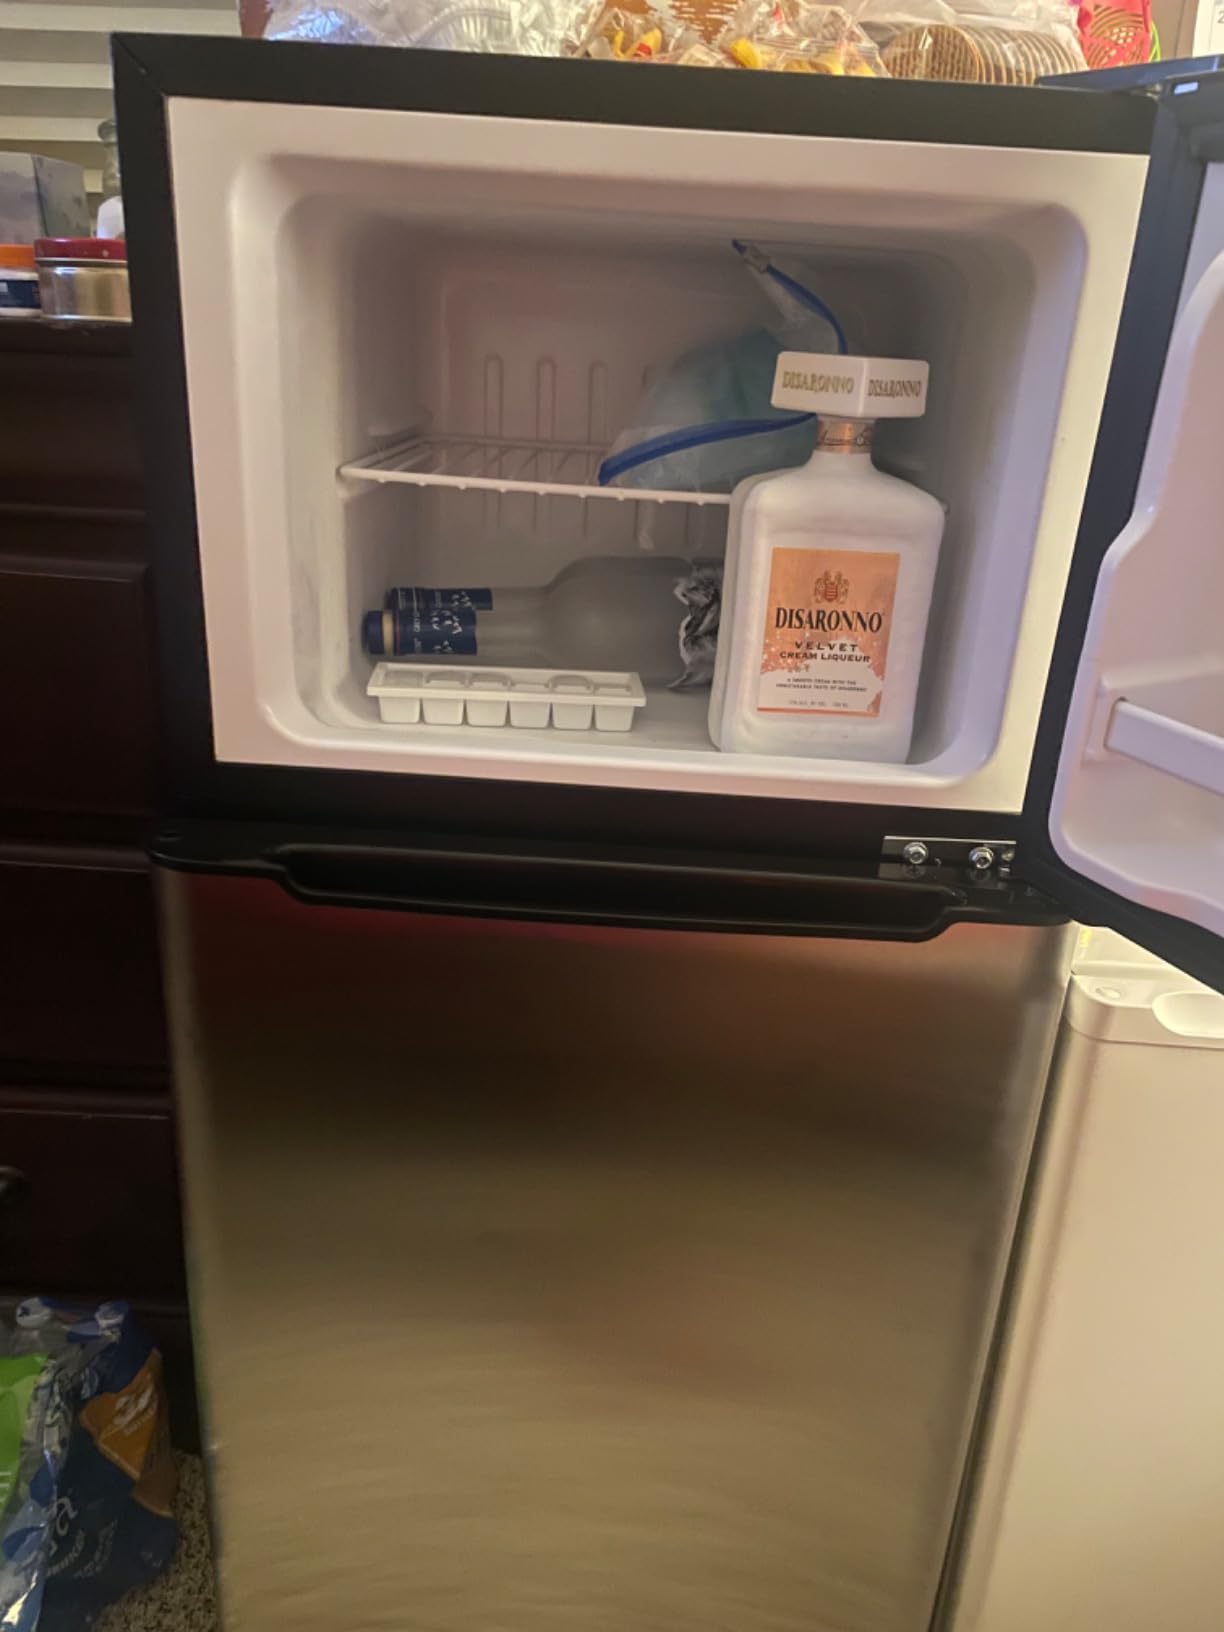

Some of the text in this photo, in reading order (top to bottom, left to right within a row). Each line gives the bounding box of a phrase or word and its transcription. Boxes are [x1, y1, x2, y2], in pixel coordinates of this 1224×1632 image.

[782, 371, 854, 394] DISARONNO
[868, 379, 921, 398] DISARONNO
[775, 607, 883, 633] DISARONNO
[795, 641, 858, 652] VELVET
[779, 651, 871, 663] CREAM LIQUEUR
